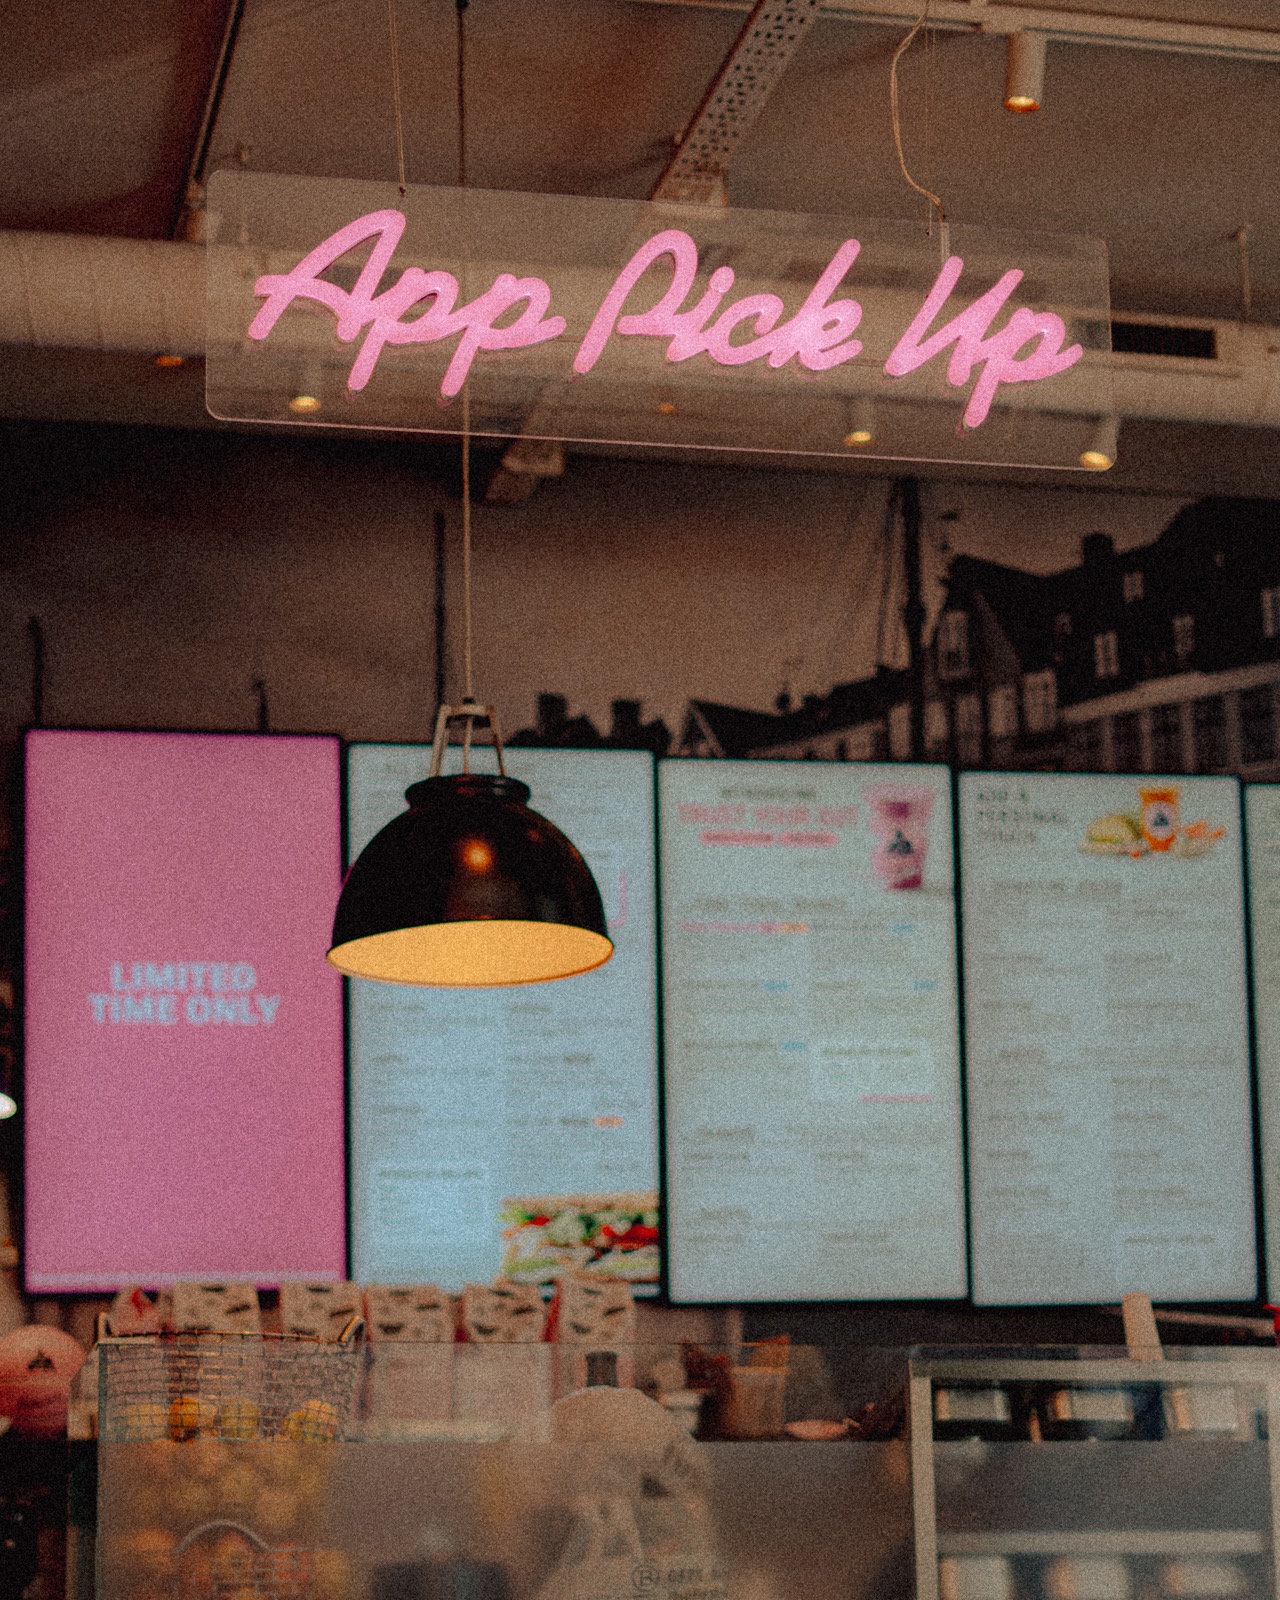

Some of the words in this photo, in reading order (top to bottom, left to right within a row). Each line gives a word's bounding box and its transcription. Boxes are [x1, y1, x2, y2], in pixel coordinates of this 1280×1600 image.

[248, 208, 567, 398] App
[573, 229, 863, 374] Pick
[884, 255, 1084, 429] Up
[111, 961, 256, 991] LIMITED
[88, 993, 178, 1025] TIME
[185, 993, 281, 1026] ONLY
